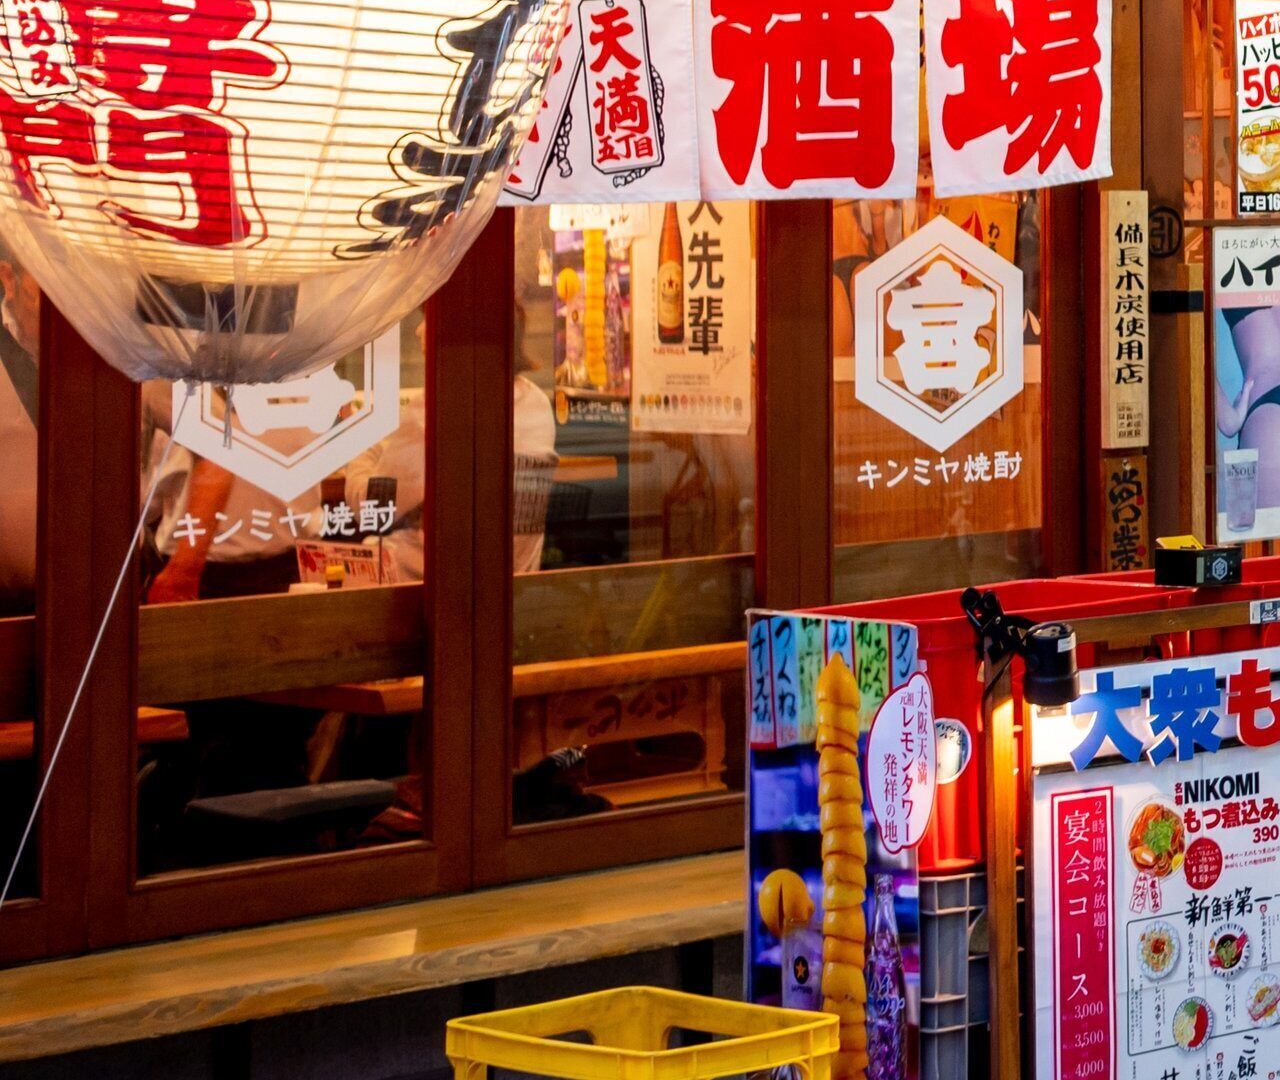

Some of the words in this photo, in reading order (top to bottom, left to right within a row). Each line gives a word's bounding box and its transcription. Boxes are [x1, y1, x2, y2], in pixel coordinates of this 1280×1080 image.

[589, 6, 651, 136] 天満
[596, 133, 654, 165] 五丁目
[1114, 221, 1147, 386] 備長木炭使用店
[857, 450, 1024, 490] キンミヤ焼酎
[172, 499, 398, 548] キンミヤ焼酎
[916, 685, 929, 788] 大阪天満
[900, 706, 915, 842] レモンタワー
[1183, 770, 1261, 805] NIKOMI
[883, 752, 898, 845] 発祥の地
[1184, 796, 1280, 834] もつ煮込み
[1252, 824, 1280, 844] 390
[1063, 809, 1091, 1002] 宴会コース
[1184, 886, 1273, 928] 新鮮第一
[1074, 1000, 1104, 1020] 3,000
[1074, 1030, 1105, 1049] 3,500
[1075, 1059, 1105, 1078] 4,000
